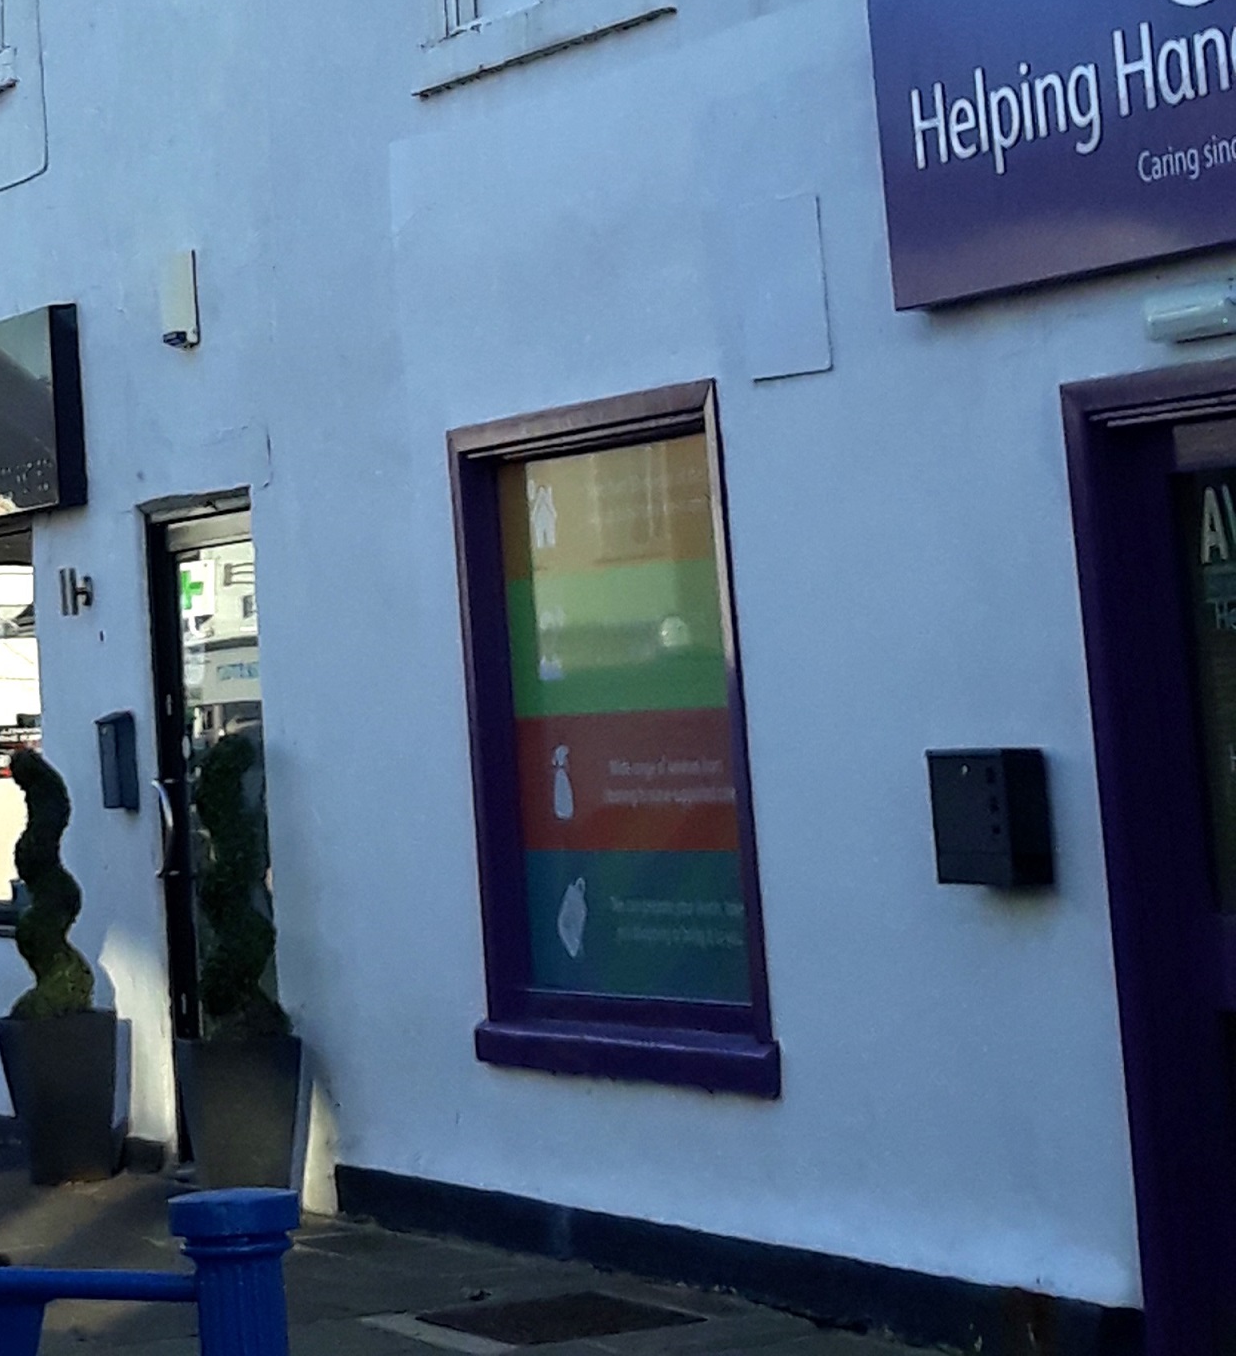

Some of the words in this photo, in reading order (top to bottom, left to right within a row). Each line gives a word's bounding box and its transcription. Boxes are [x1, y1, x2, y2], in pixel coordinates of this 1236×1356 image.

[910, 62, 1103, 176] Helping
[1112, 21, 1236, 118] Han
[1138, 146, 1200, 183] Caring
